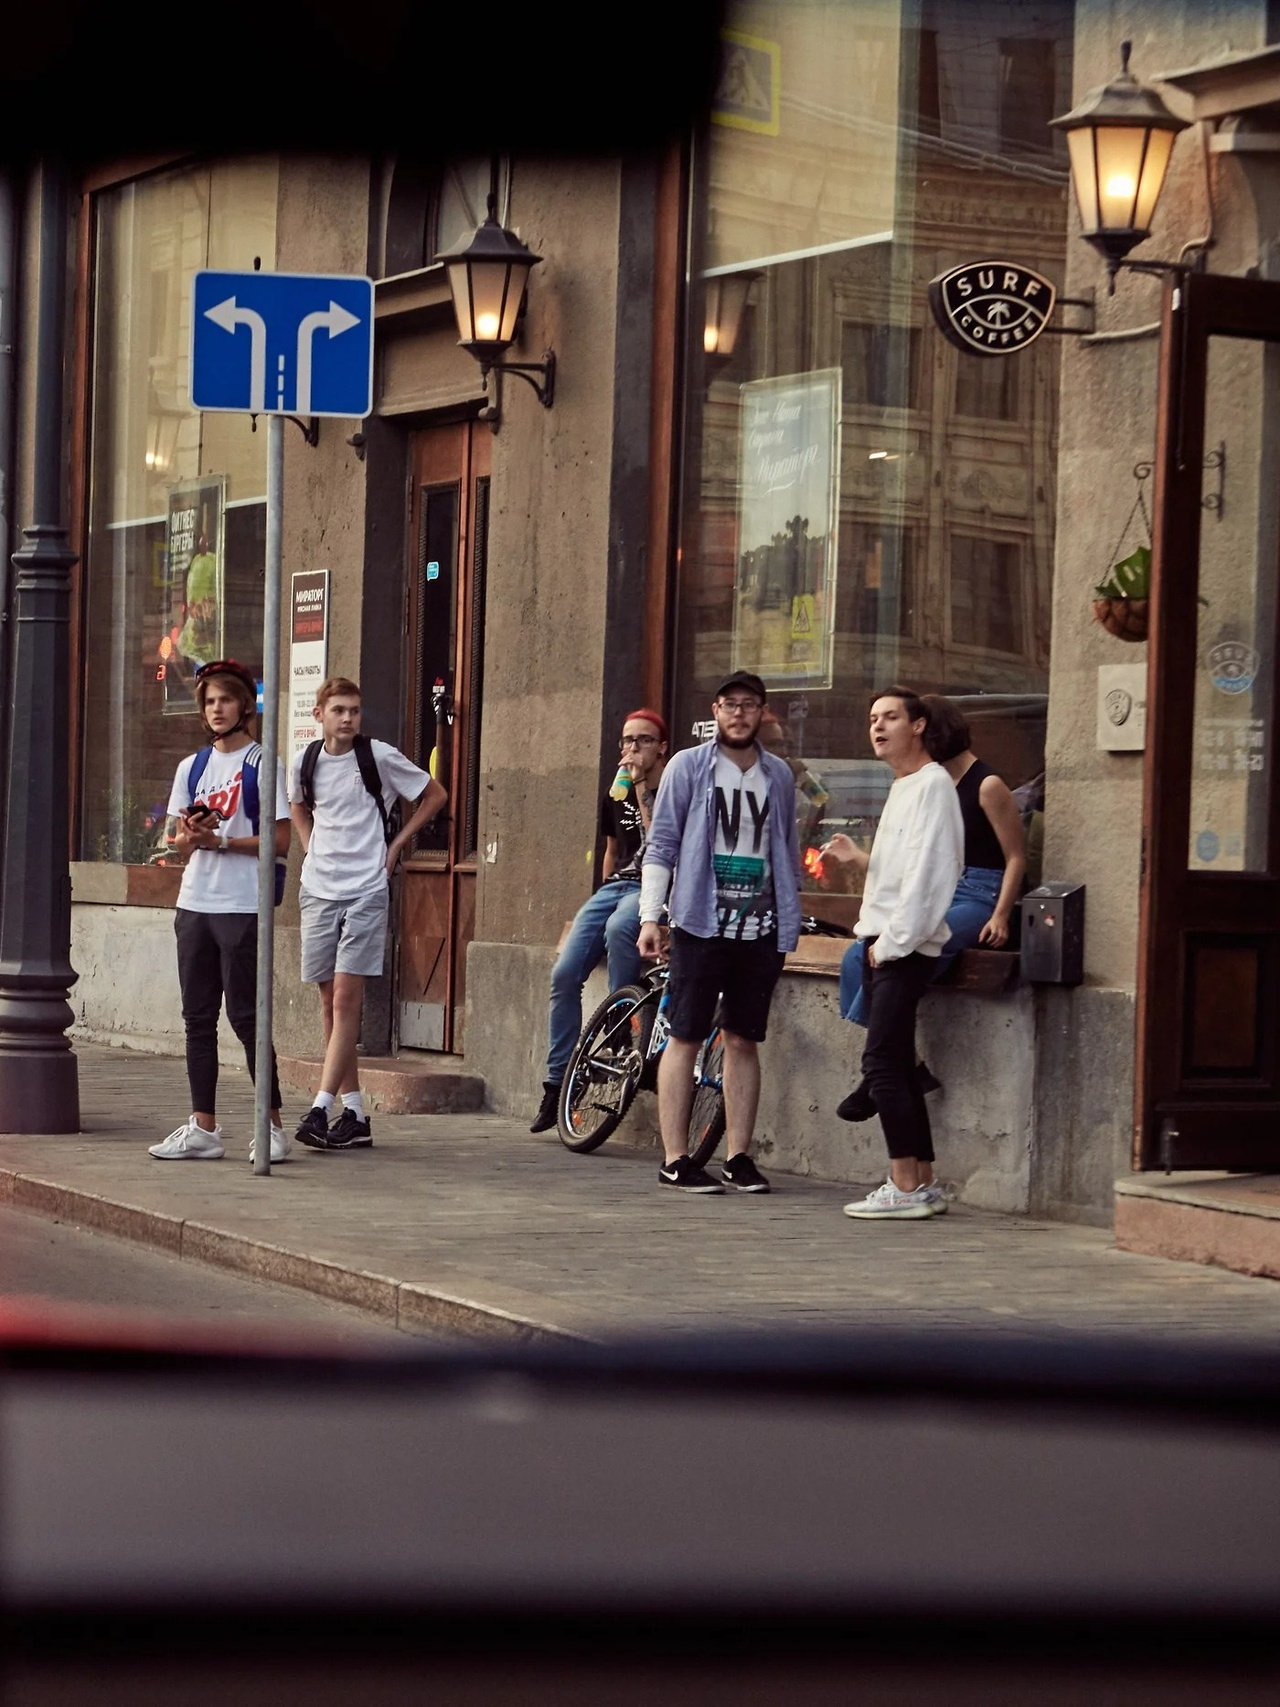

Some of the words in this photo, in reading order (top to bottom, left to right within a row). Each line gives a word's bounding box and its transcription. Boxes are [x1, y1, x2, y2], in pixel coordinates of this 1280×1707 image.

[956, 269, 1042, 298] SURF
[961, 314, 1036, 345] COFFEE
[295, 588, 324, 603] МИРАТОРГ
[194, 771, 243, 818] RJ
[714, 786, 770, 853] NY
